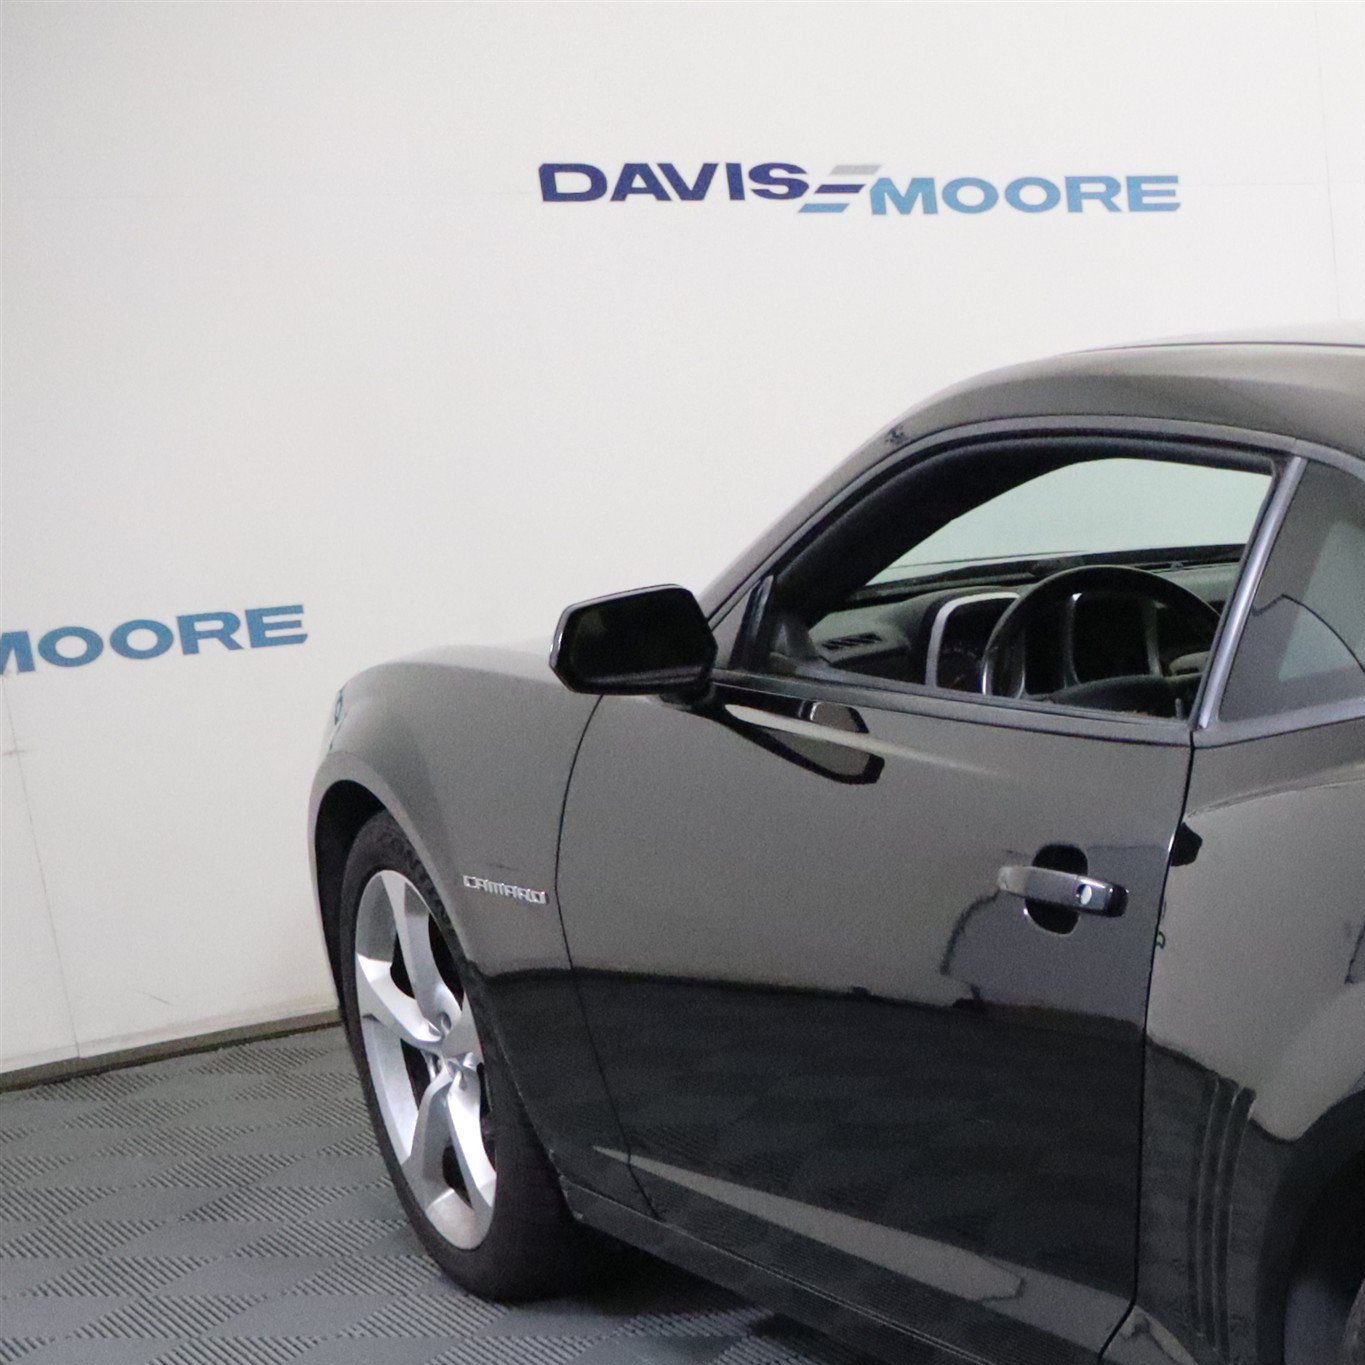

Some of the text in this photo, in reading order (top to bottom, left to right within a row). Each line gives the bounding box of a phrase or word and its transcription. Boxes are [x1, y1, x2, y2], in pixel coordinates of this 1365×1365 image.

[539, 161, 1181, 215] DAVIS MOORE
[462, 874, 547, 904] CAMARO
